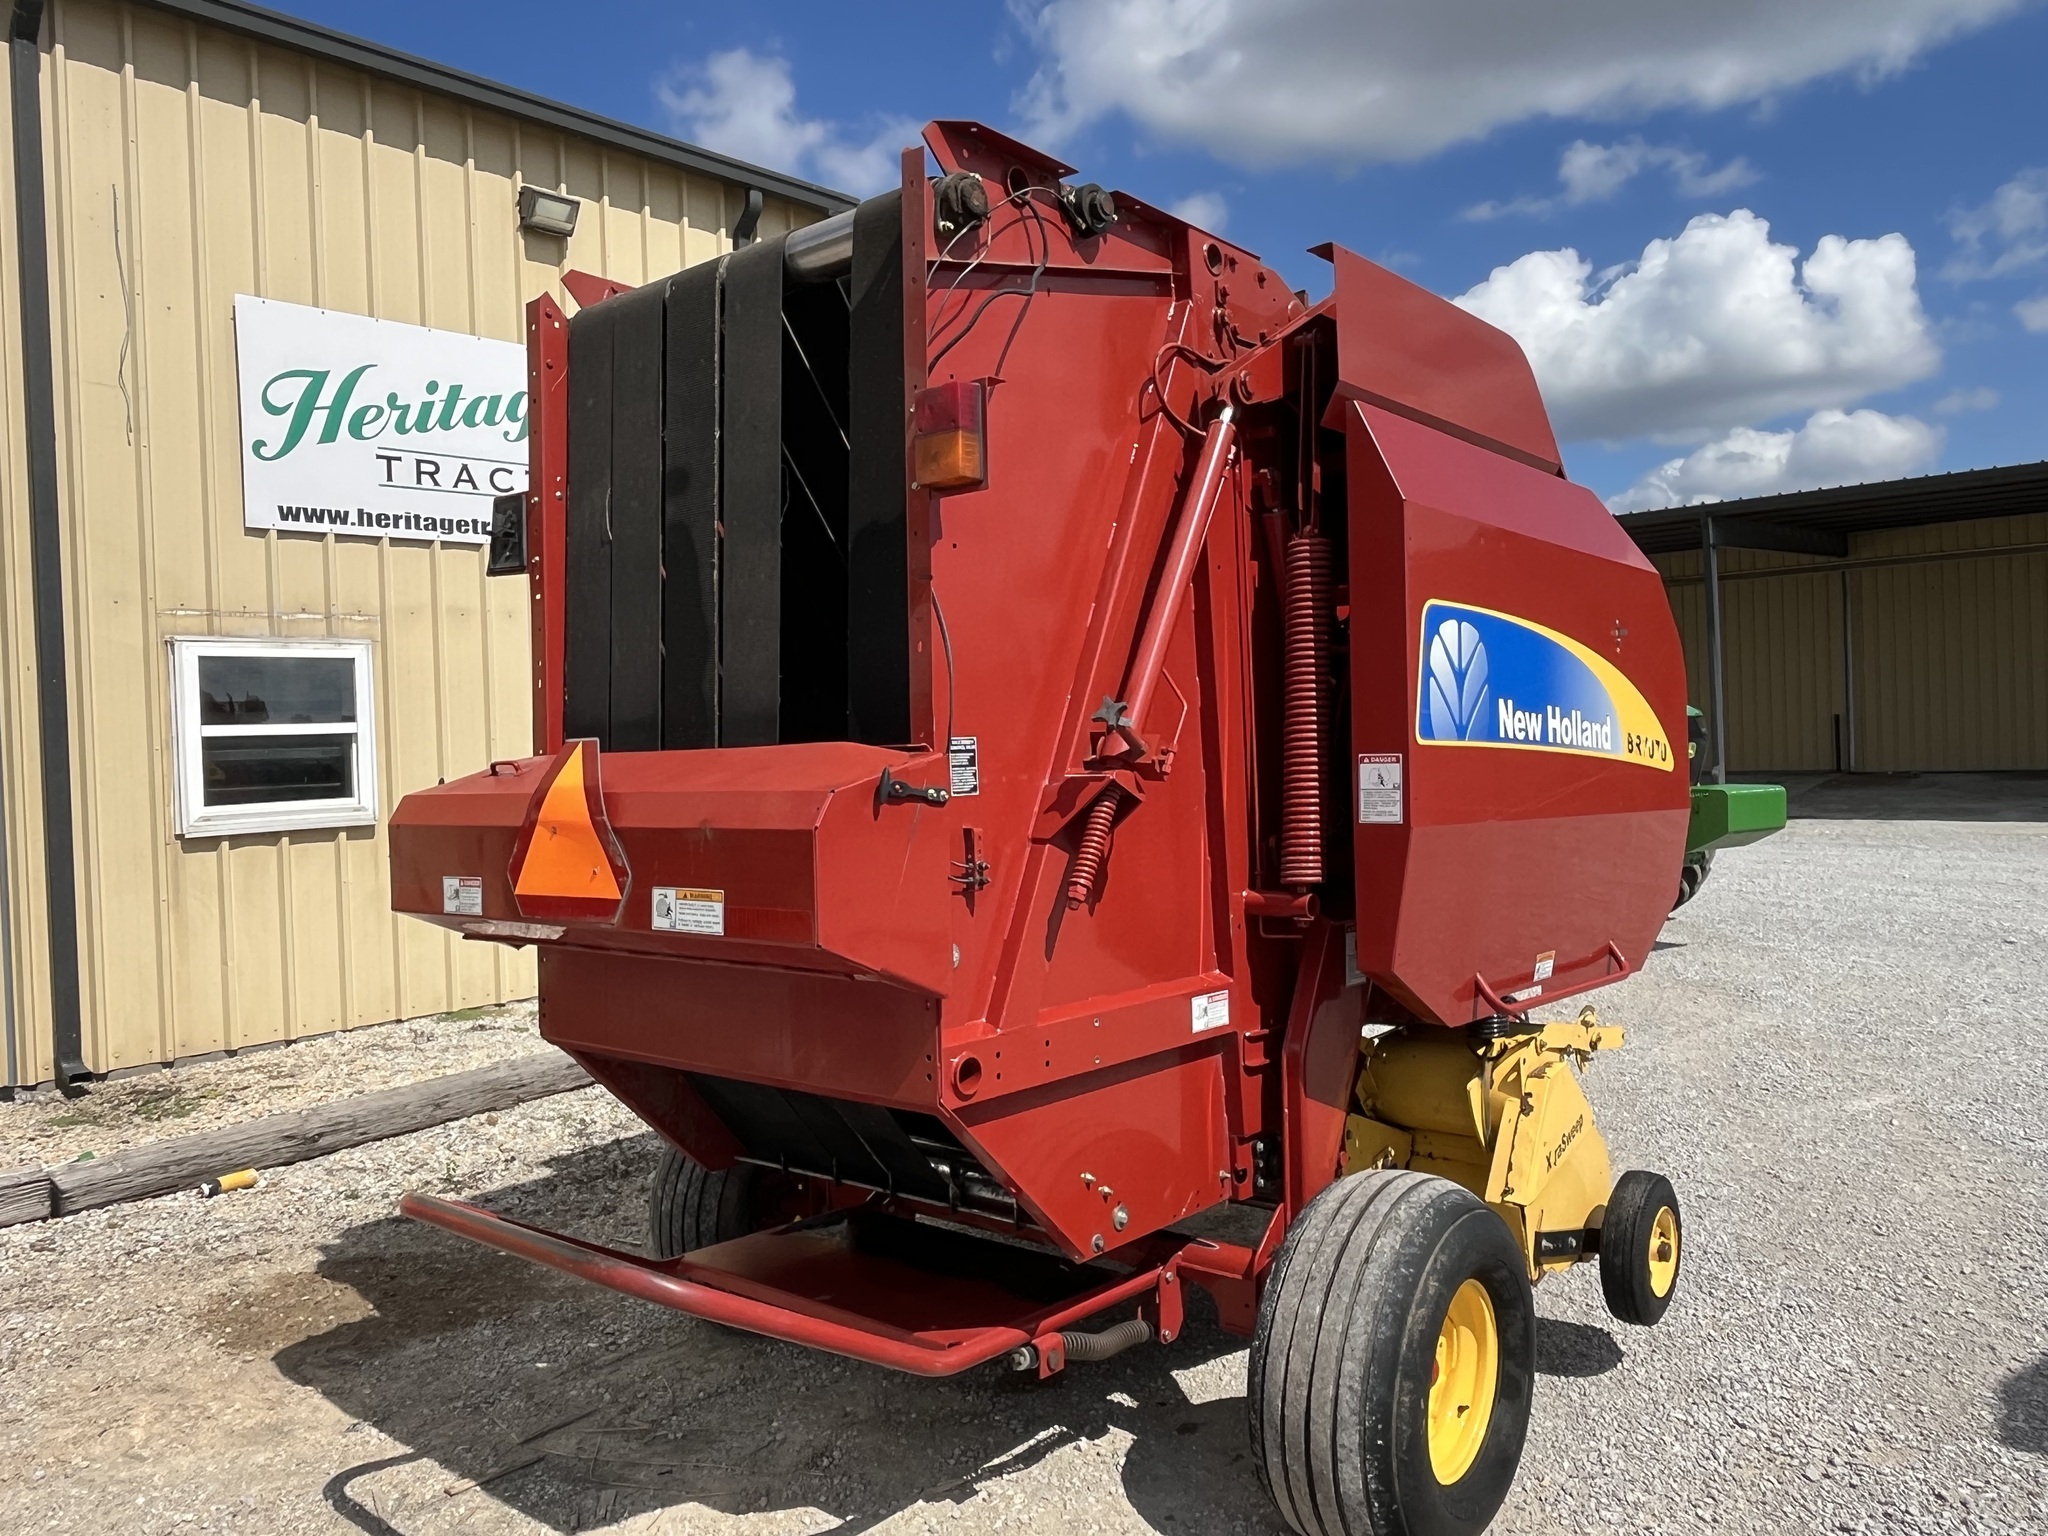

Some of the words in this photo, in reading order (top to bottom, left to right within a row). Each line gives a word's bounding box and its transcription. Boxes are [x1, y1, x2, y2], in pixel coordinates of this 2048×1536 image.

[375, 454, 529, 493] TRAC
[1498, 697, 1543, 742] New
[1546, 705, 1612, 751] Holland
